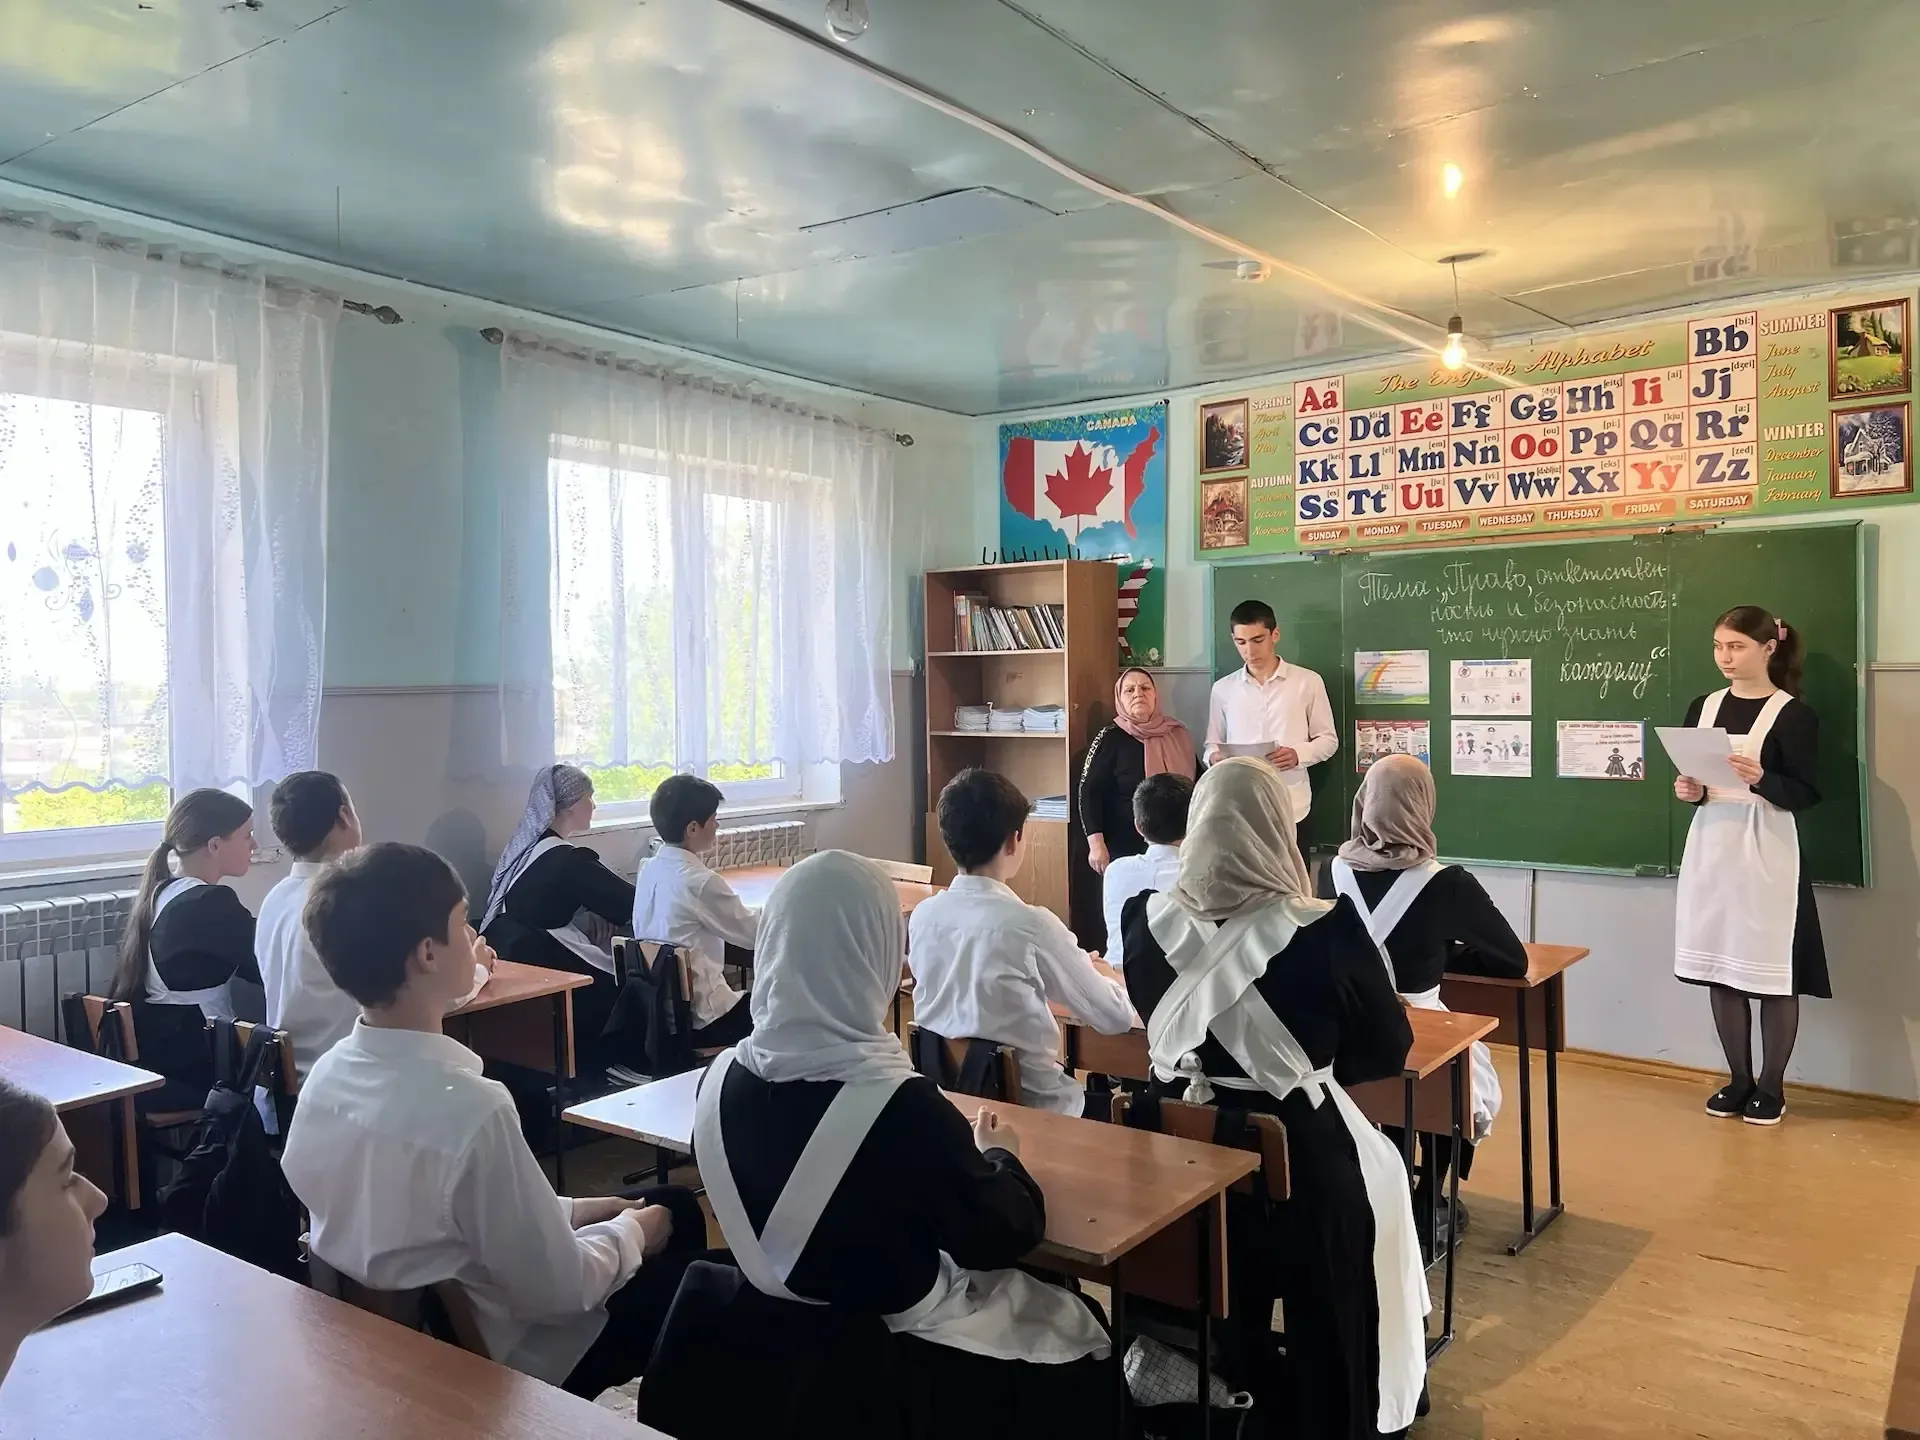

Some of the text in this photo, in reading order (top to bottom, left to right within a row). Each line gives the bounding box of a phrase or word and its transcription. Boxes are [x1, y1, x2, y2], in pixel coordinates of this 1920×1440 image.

[1759, 313, 1826, 336] SUMMER
[1694, 325, 1749, 356] Bb
[1764, 343, 1800, 362] June
[1375, 340, 1655, 394] The English Alphabet
[1764, 364, 1796, 382] July
[1632, 377, 1663, 406] Ii
[1692, 368, 1731, 400] Jj
[1764, 381, 1821, 400] August
[1252, 396, 1291, 411] SPRING
[1299, 386, 1338, 413] Aa
[1510, 394, 1557, 421] Gg
[1566, 385, 1615, 415] Hh
[1086, 415, 1137, 431] CANADA
[1253, 411, 1287, 424] March
[1349, 412, 1391, 441] Dd
[1400, 407, 1443, 435] Ee
[1452, 400, 1491, 428] Ff
[1695, 410, 1749, 441] Rr
[1300, 423, 1339, 446] Cc
[1570, 427, 1618, 456] Pp
[1631, 419, 1684, 450] Qq
[1764, 422, 1825, 441] WINTER
[1253, 443, 1278, 454] May
[1453, 440, 1500, 467] Nn
[1511, 433, 1558, 459] Oo
[1764, 447, 1824, 463] December
[1300, 457, 1338, 484] Kk
[1349, 452, 1381, 478] Ll
[1398, 446, 1445, 473] Mm
[1696, 452, 1750, 484] Zz
[1251, 475, 1292, 489] AUTUMN
[1507, 471, 1560, 500] Ww
[1568, 465, 1619, 495] Xx
[1631, 461, 1683, 492] Yy
[1763, 467, 1817, 485] January
[1347, 488, 1387, 515] Tt
[1401, 483, 1444, 510] Uu
[1454, 477, 1499, 505] Vv
[1689, 495, 1749, 509] SATURDAY
[1764, 487, 1822, 503] February
[1300, 494, 1339, 520] Ss
[1479, 513, 1534, 526] WEDNESDAY
[1547, 507, 1600, 520] THURSDAY
[1624, 502, 1663, 514] FRIDAY
[1308, 530, 1342, 541] SUNDAY
[1364, 524, 1401, 535] MONDAY
[1422, 519, 1464, 531] TUESDAY
[1431, 602, 1494, 622] ность
[1507, 602, 1526, 616] и
[1437, 628, 1474, 644] что
[1562, 622, 1637, 662] знать
